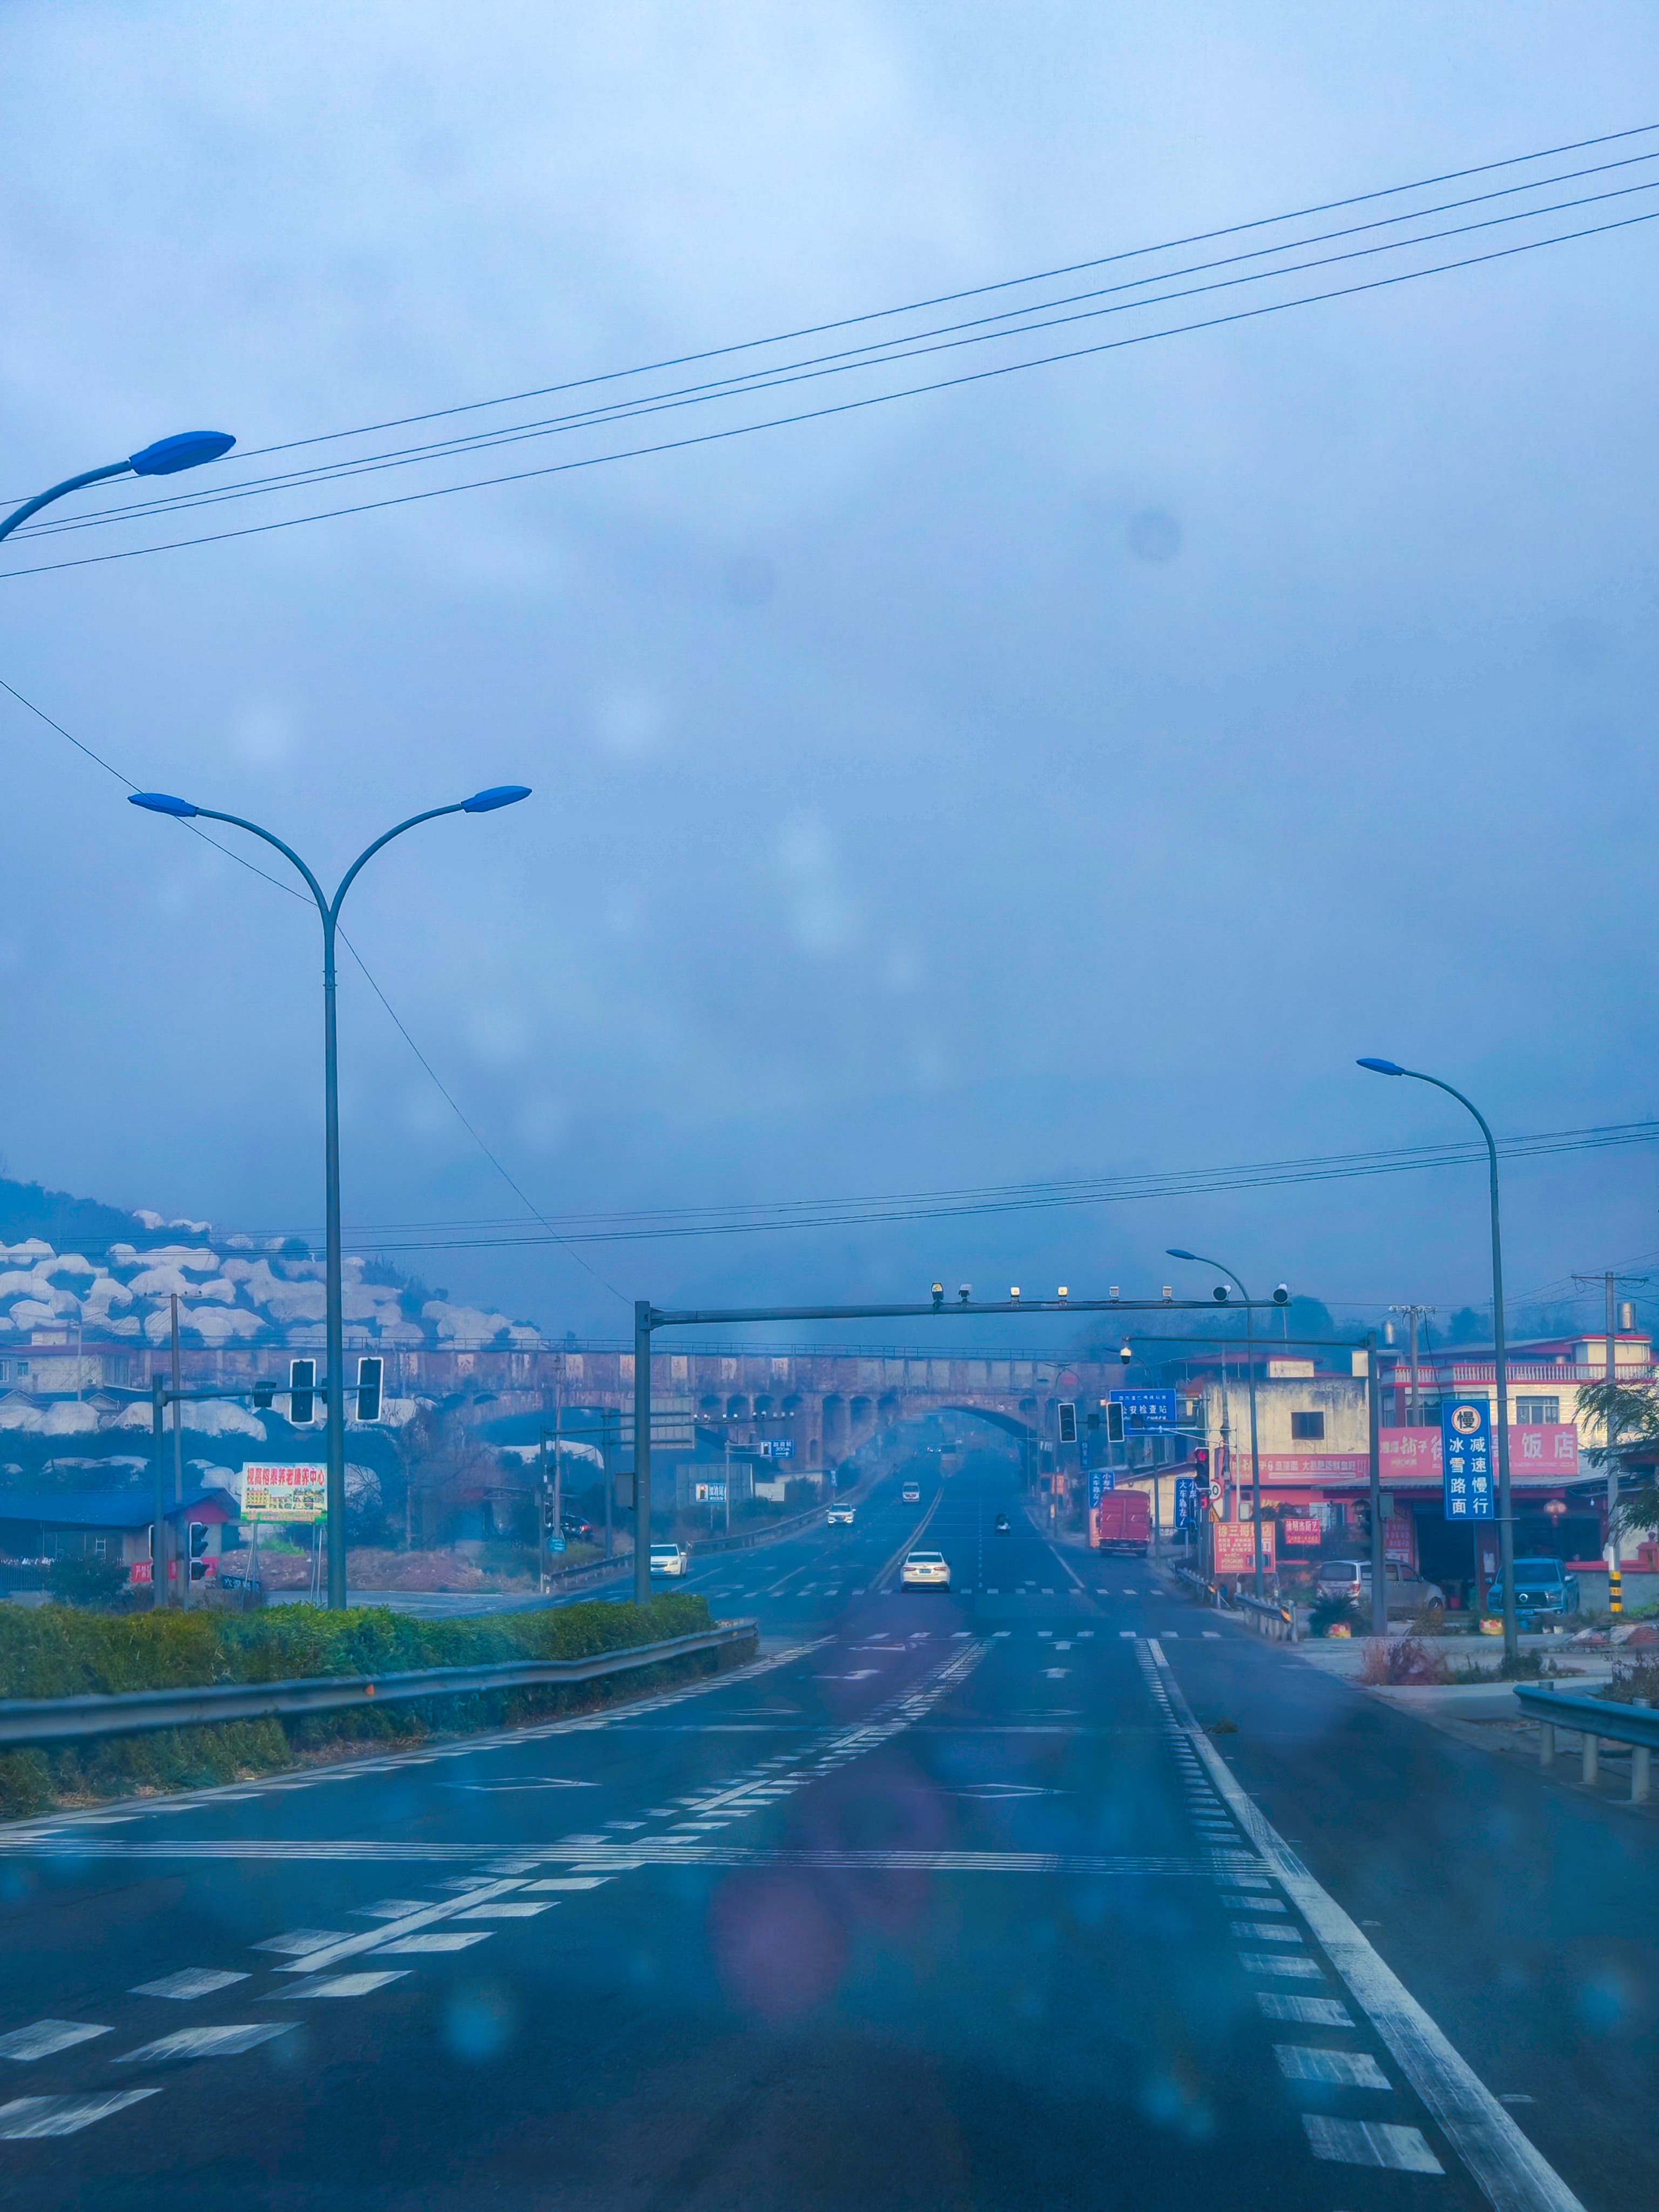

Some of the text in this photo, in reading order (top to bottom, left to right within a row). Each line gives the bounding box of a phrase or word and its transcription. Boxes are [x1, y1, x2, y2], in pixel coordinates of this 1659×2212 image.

[1457, 1411, 1475, 1429] 慢
[1449, 1437, 1467, 1514] 冰雪路面
[1470, 1437, 1488, 1514] 减速慢行
